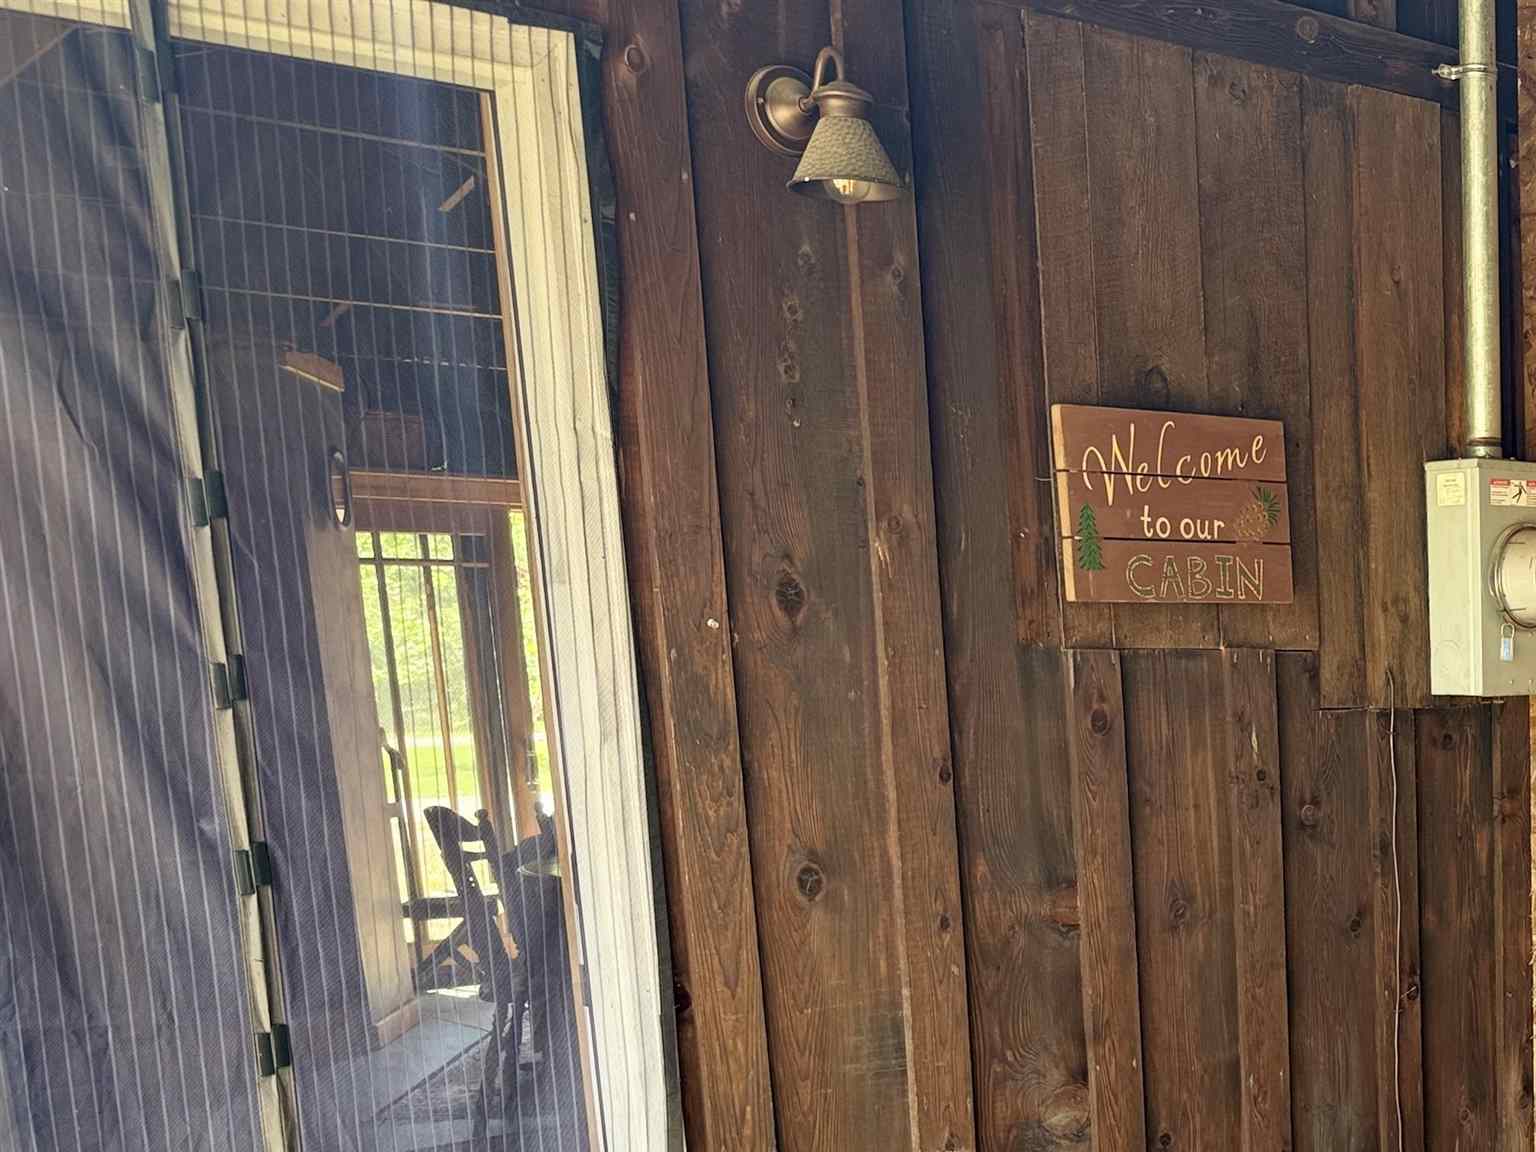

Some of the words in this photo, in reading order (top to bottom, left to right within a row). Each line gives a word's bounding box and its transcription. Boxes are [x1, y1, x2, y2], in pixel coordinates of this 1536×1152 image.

[1082, 421, 1267, 506] Welcome
[1140, 505, 1171, 539] to
[1179, 517, 1225, 540] our
[1126, 553, 1264, 601] CABIN
